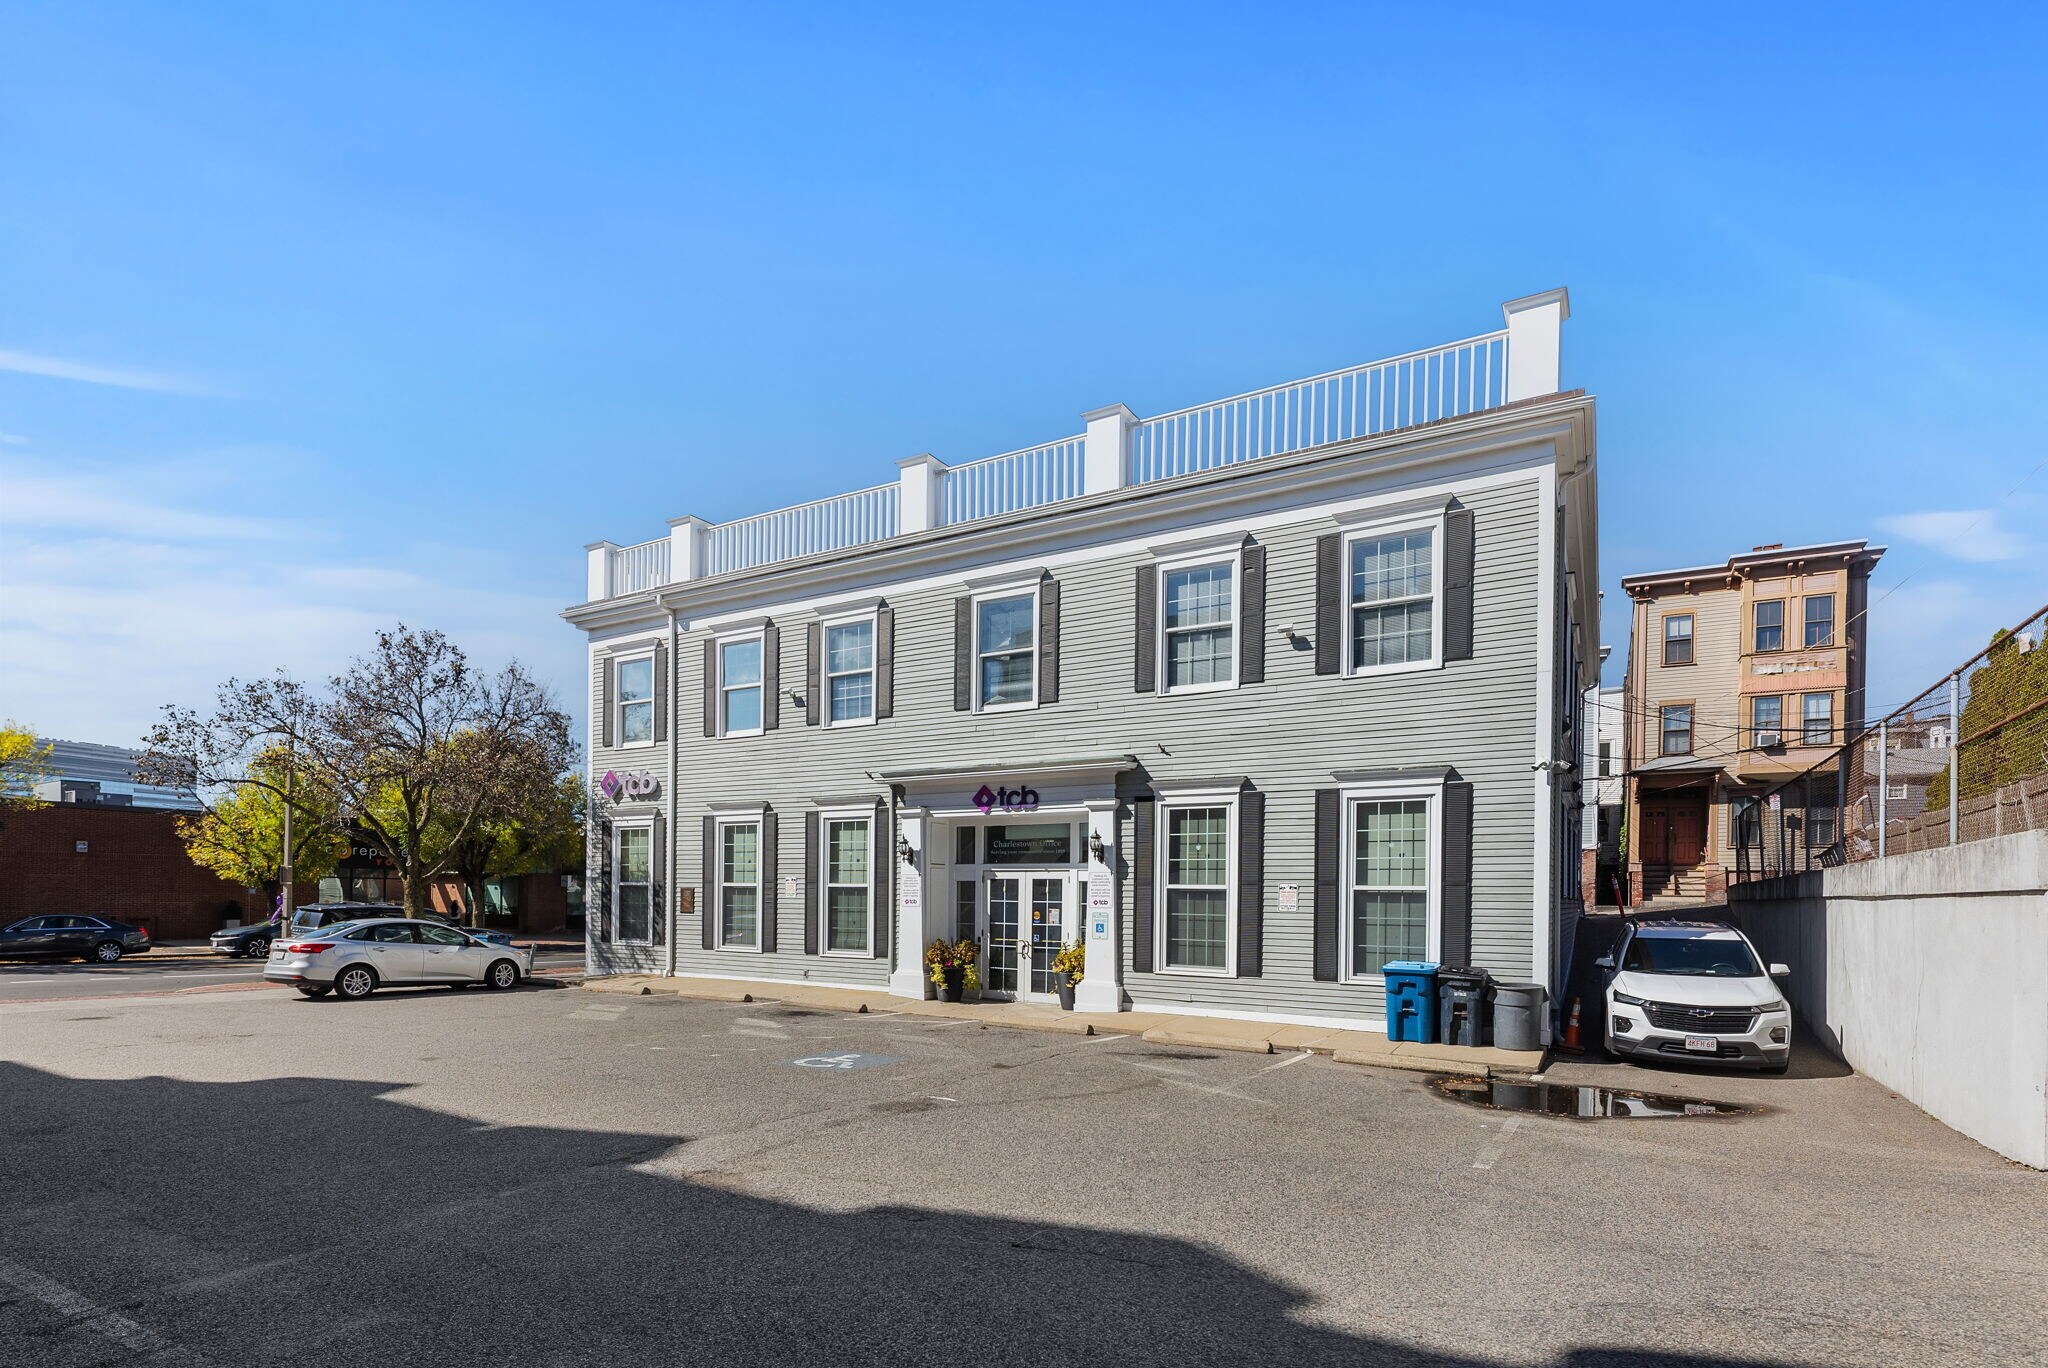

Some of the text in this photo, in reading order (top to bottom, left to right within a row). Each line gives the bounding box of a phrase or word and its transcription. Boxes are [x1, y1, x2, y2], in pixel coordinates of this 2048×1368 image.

[615, 770, 658, 795] tcb
[997, 785, 1039, 809] tcb
[993, 840, 1038, 848] Charlestown
